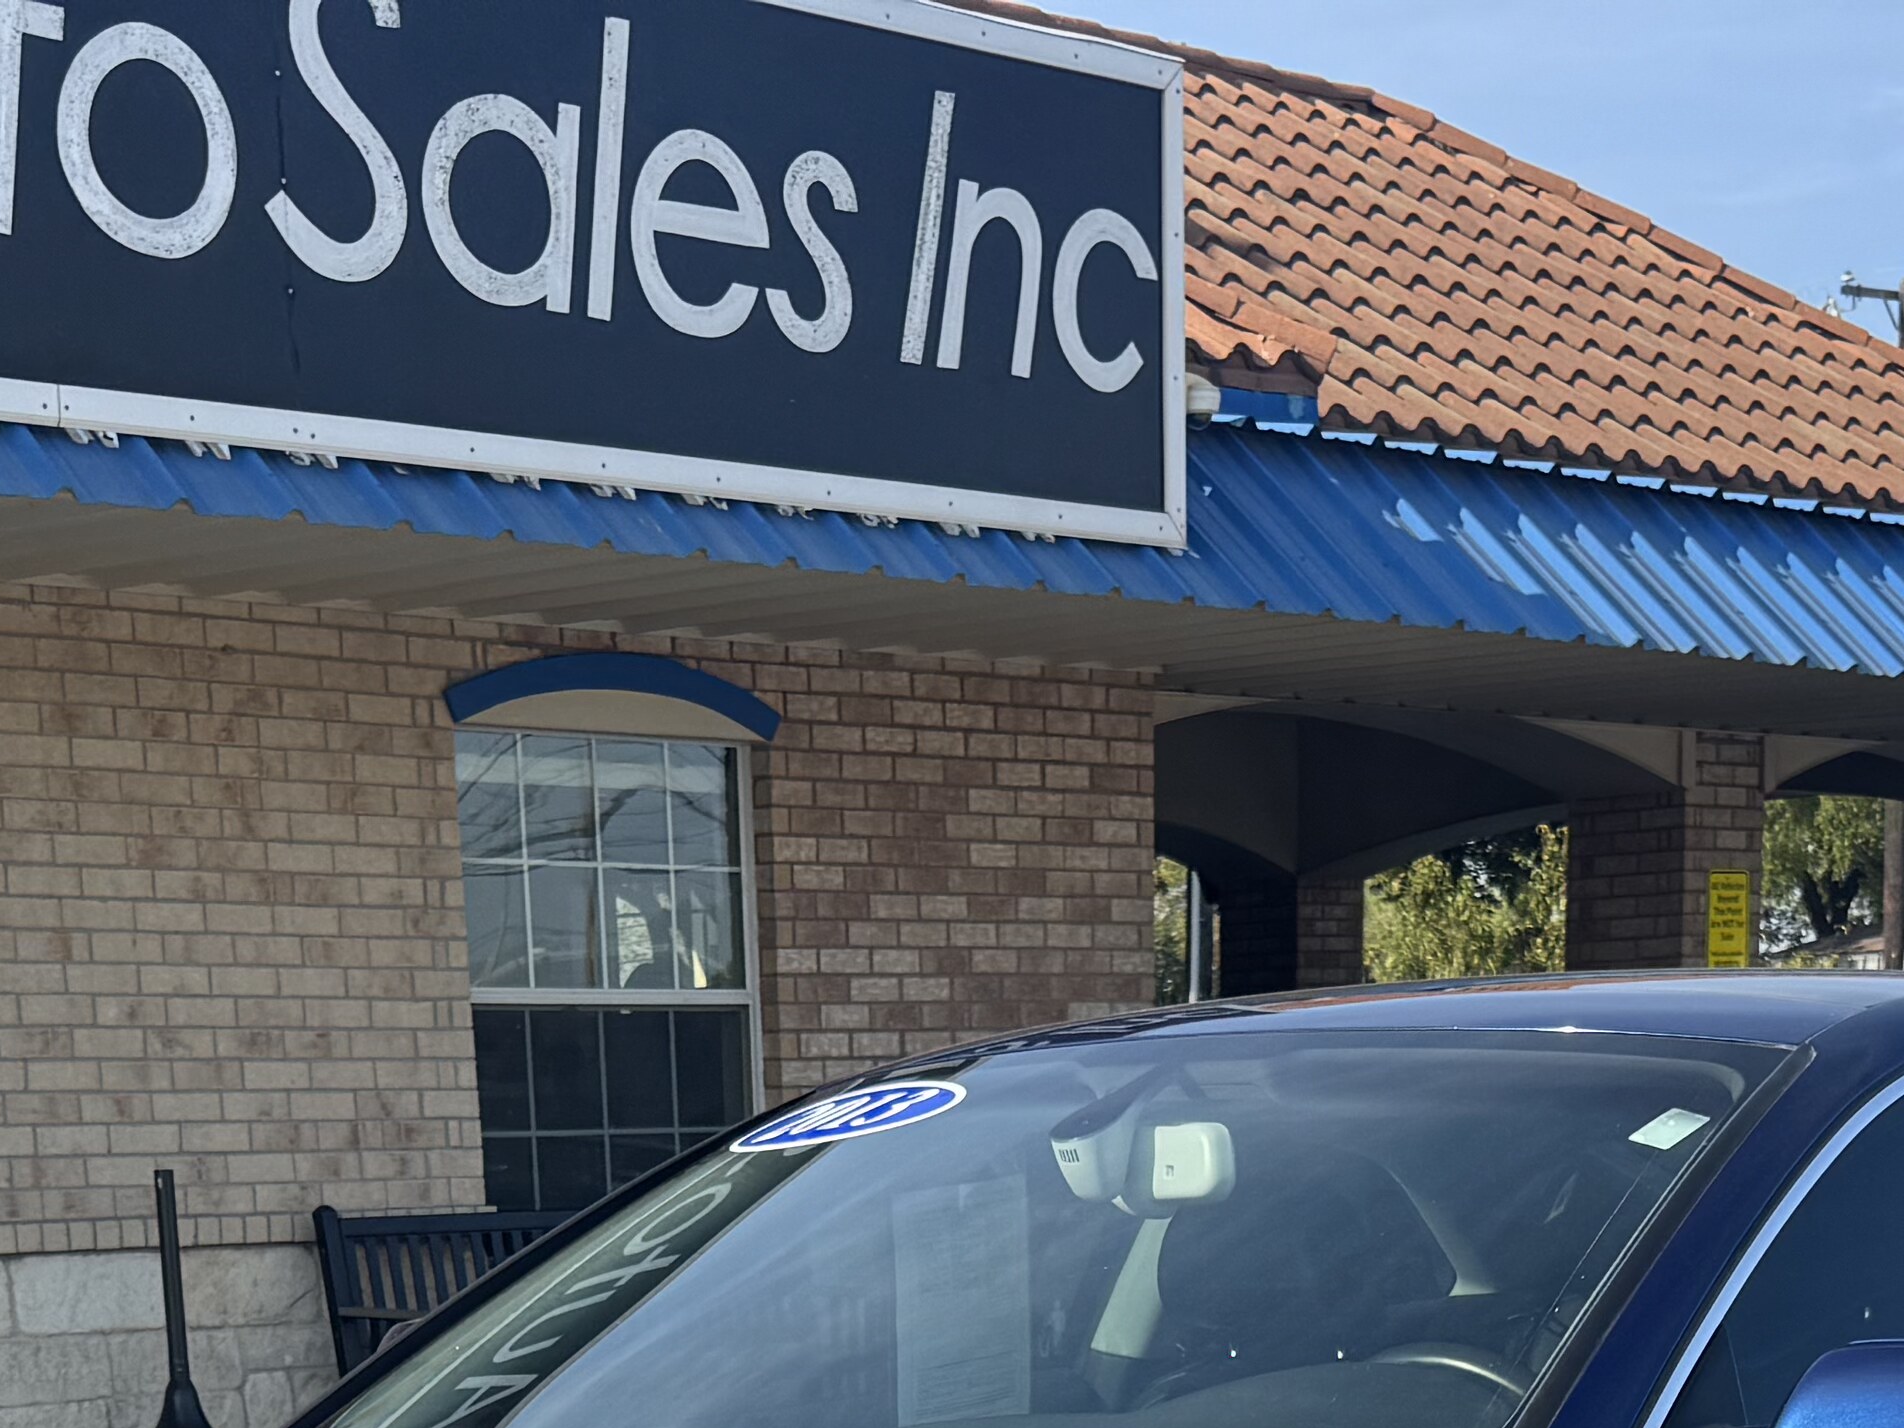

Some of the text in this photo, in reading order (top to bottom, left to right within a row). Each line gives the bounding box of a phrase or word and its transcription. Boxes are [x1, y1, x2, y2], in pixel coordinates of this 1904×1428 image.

[264, 0, 859, 354] Sales
[900, 90, 1159, 394] Inc
[750, 1088, 941, 1144] 2013
